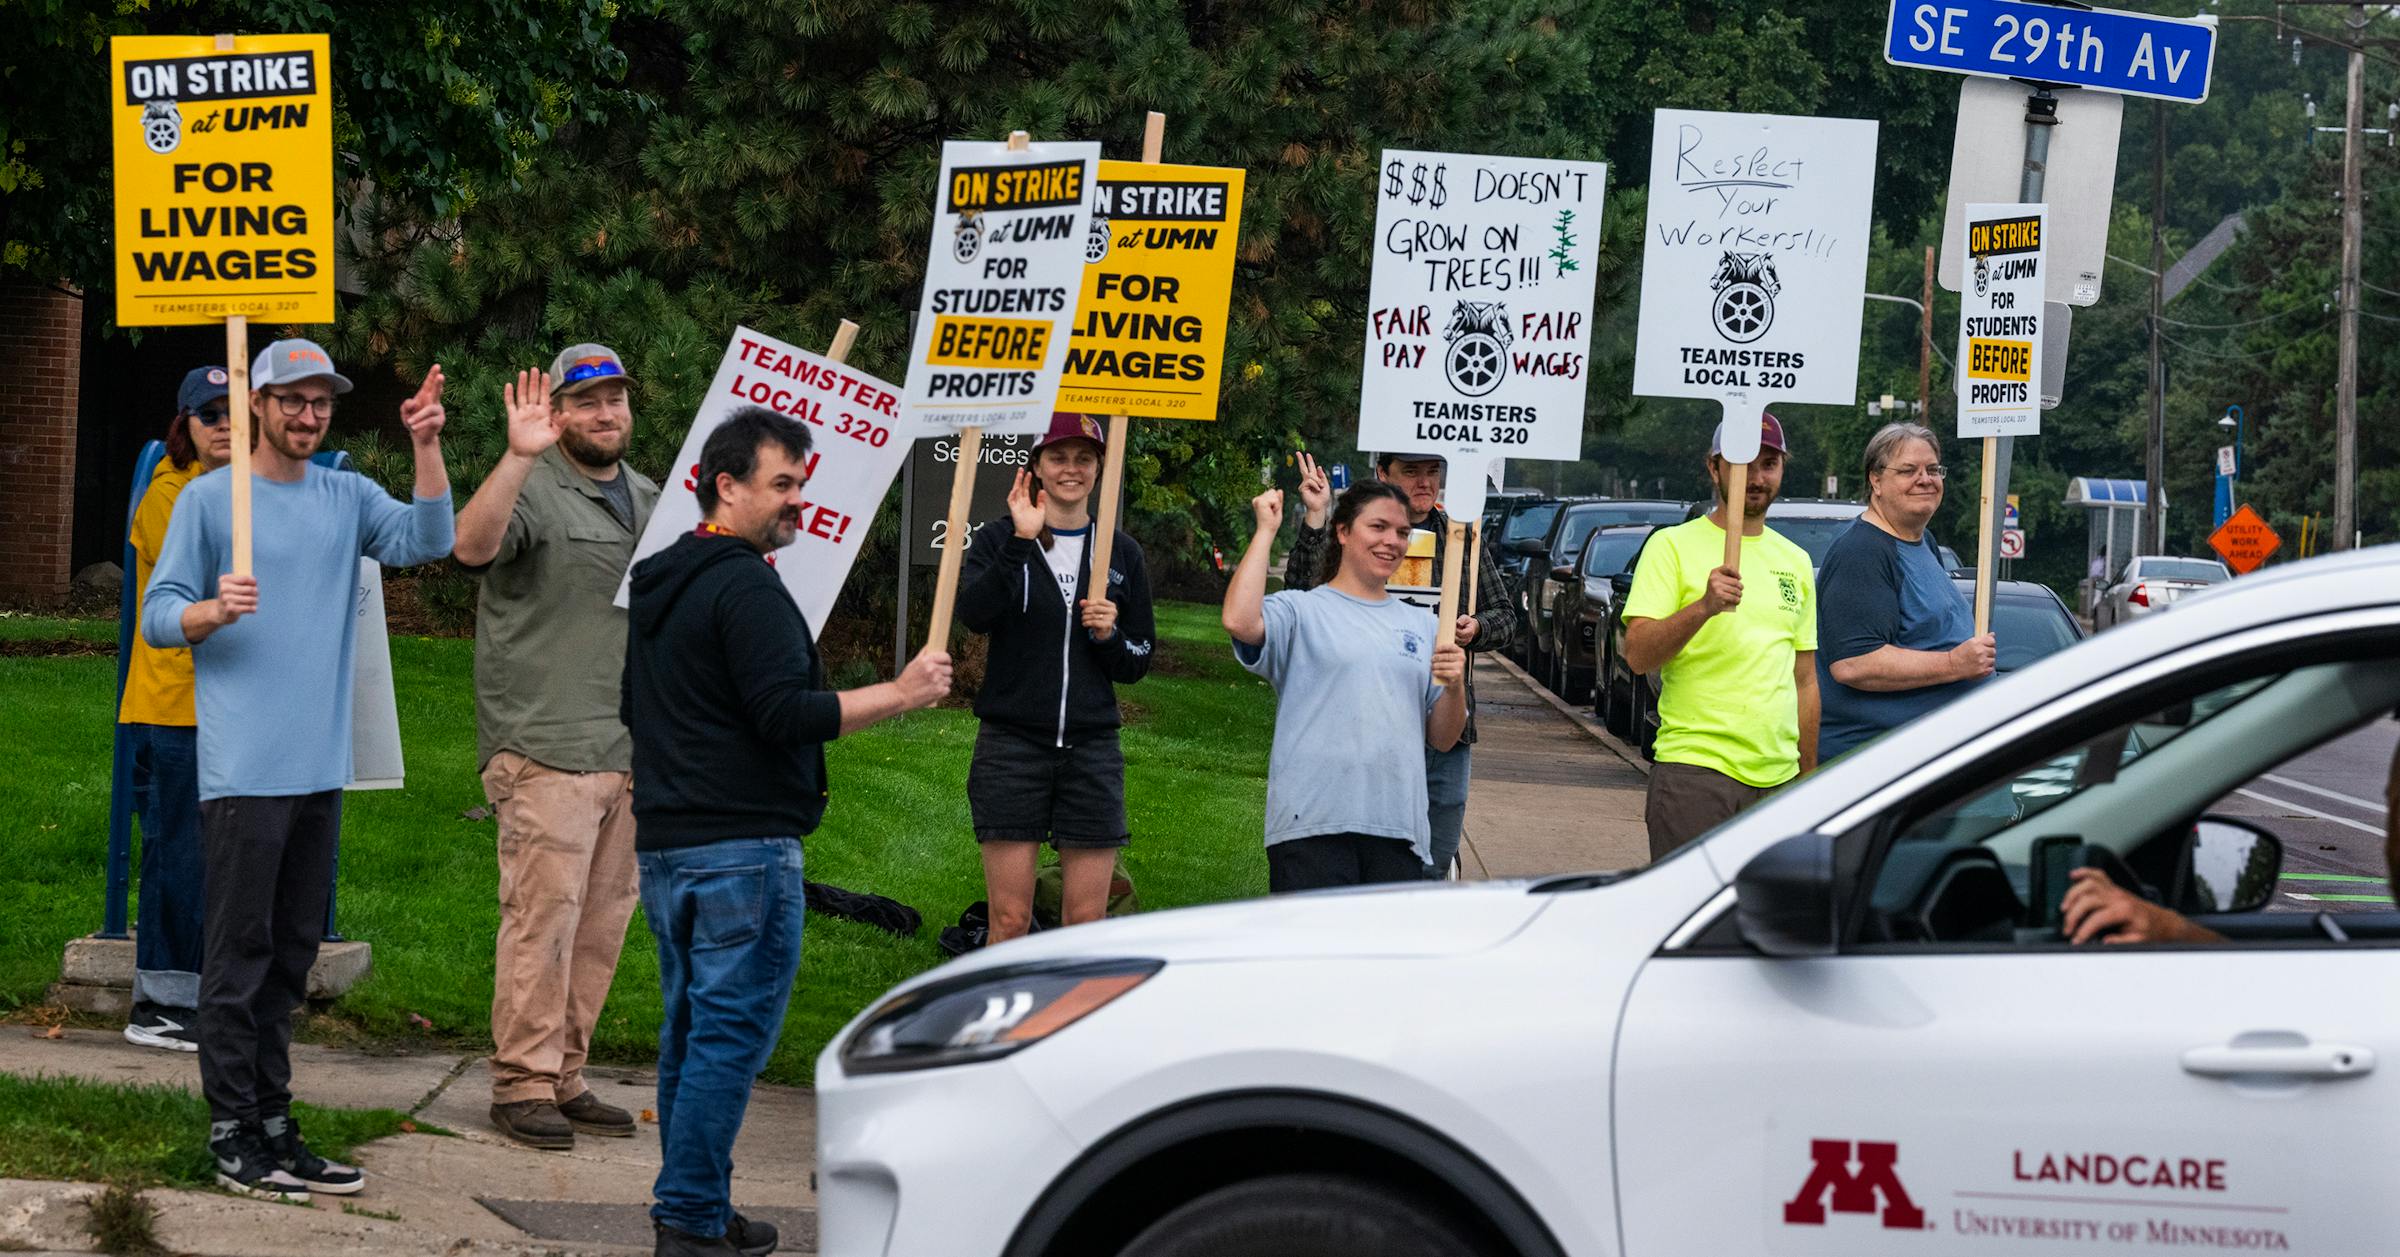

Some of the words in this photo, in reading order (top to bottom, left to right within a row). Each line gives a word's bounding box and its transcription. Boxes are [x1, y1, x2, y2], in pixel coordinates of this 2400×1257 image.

[1908, 4, 1968, 56] SE
[1989, 14, 2104, 73] 29th
[2127, 32, 2191, 84] Av
[131, 64, 179, 99] ON
[186, 56, 310, 95] STRIKE
[191, 109, 220, 133] at
[223, 104, 310, 132] UMN
[174, 162, 273, 194] FOR
[953, 172, 990, 207] ON
[994, 165, 1081, 205] STRIKE
[1384, 158, 1447, 210] $$$
[1474, 167, 1589, 205] DOESN'T
[1094, 186, 1113, 215] N
[1120, 186, 1222, 216] STRIKE
[1716, 186, 1779, 220] Your
[140, 204, 308, 238] LIVING
[988, 219, 1012, 243] at
[1012, 213, 1075, 242] UMN
[1117, 229, 1144, 249] at
[1144, 228, 1219, 250] UMN
[1386, 218, 1468, 262] GROW
[1484, 224, 1519, 254] ON
[1971, 226, 1990, 253] ON
[1992, 220, 2039, 251] STRIKE
[132, 248, 317, 282] WAGES
[983, 257, 1028, 279] FOR
[1991, 262, 2004, 281] at
[2004, 258, 2038, 281] UMN
[931, 287, 1066, 314] STUDENTS
[1096, 273, 1180, 304] FOR
[1991, 291, 2015, 310] FOR
[153, 303, 226, 313] TEAMSTERS
[231, 302, 271, 313] LOCAL
[276, 301, 300, 312] 320
[1373, 305, 1431, 340] FAIR
[1522, 311, 1582, 342] FAIR
[1966, 315, 2037, 337] STUDENTS
[937, 322, 1046, 362] BEFORE
[1383, 342, 1427, 369] PAY
[1512, 352, 1584, 380] WAGES
[1680, 347, 1804, 369] TEAMSTERS
[1972, 343, 2029, 375] BEFORE
[927, 370, 1036, 398] PROFITS
[1684, 367, 1751, 387] LOCAL
[1757, 371, 1797, 389] 320
[1064, 393, 1126, 405] TEAMSTERS
[1129, 397, 1162, 408] LOCAL
[1166, 399, 1186, 409] 320
[1971, 382, 2028, 405] PROFITS
[730, 375, 824, 426] LOCAL
[834, 412, 890, 448] 320
[1413, 401, 1537, 424] TEAMSTERS
[1416, 423, 1483, 443] LOCAL
[1489, 426, 1529, 445] 320
[2226, 525, 2263, 535] UTILITY
[2231, 537, 2259, 546] WORK
[2229, 550, 2263, 559] AHEAD
[2012, 1149, 2227, 1191] LANDCARE
